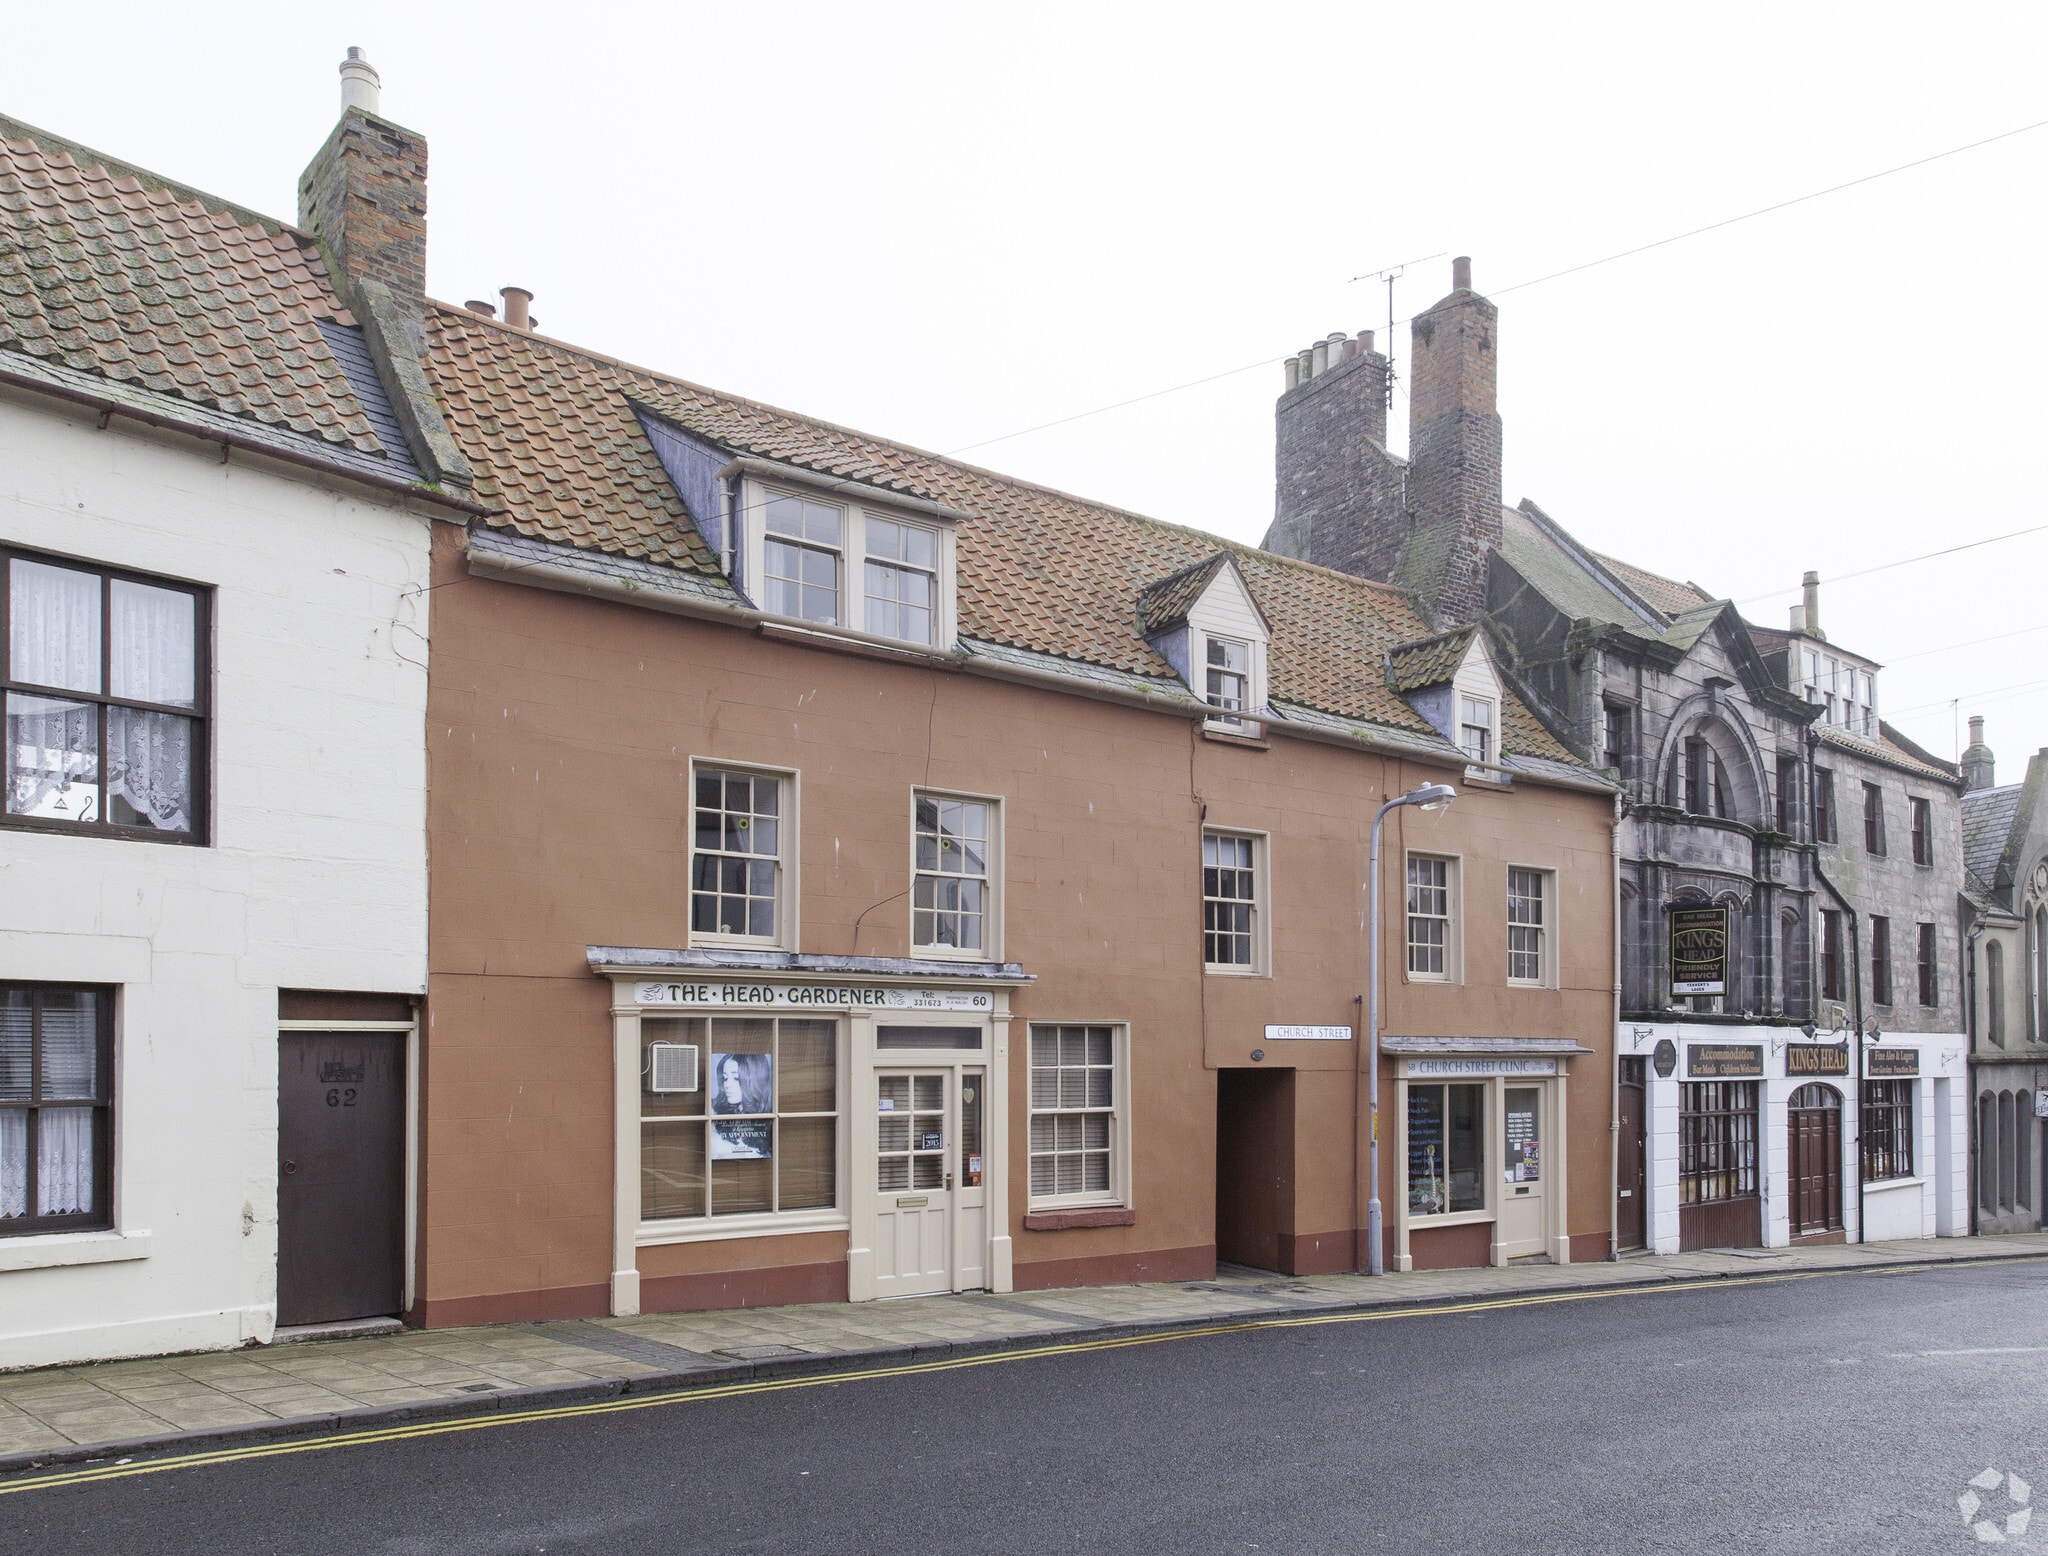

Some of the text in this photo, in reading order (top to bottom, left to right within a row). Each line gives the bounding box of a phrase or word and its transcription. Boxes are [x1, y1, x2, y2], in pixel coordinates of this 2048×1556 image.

[1676, 931, 1724, 948] KINGS
[1683, 949, 1716, 960] HEAD
[668, 985, 885, 1004] THE HEAD GARDENER
[921, 991, 935, 999] Tel:
[972, 996, 986, 1006] 60
[1277, 1027, 1349, 1038] CHURCH STREET
[1699, 1047, 1755, 1060] Accommodation
[1789, 1048, 1848, 1071] KINGS HEAD
[1875, 1051, 1886, 1060] Fine
[1419, 1061, 1463, 1073] CHURCH
[1465, 1060, 1496, 1073] STREET
[1500, 1060, 1529, 1072] CLINIC
[1720, 1064, 1740, 1073] Children
[1740, 1064, 1760, 1073] Welcome
[326, 1088, 357, 1107] 62
